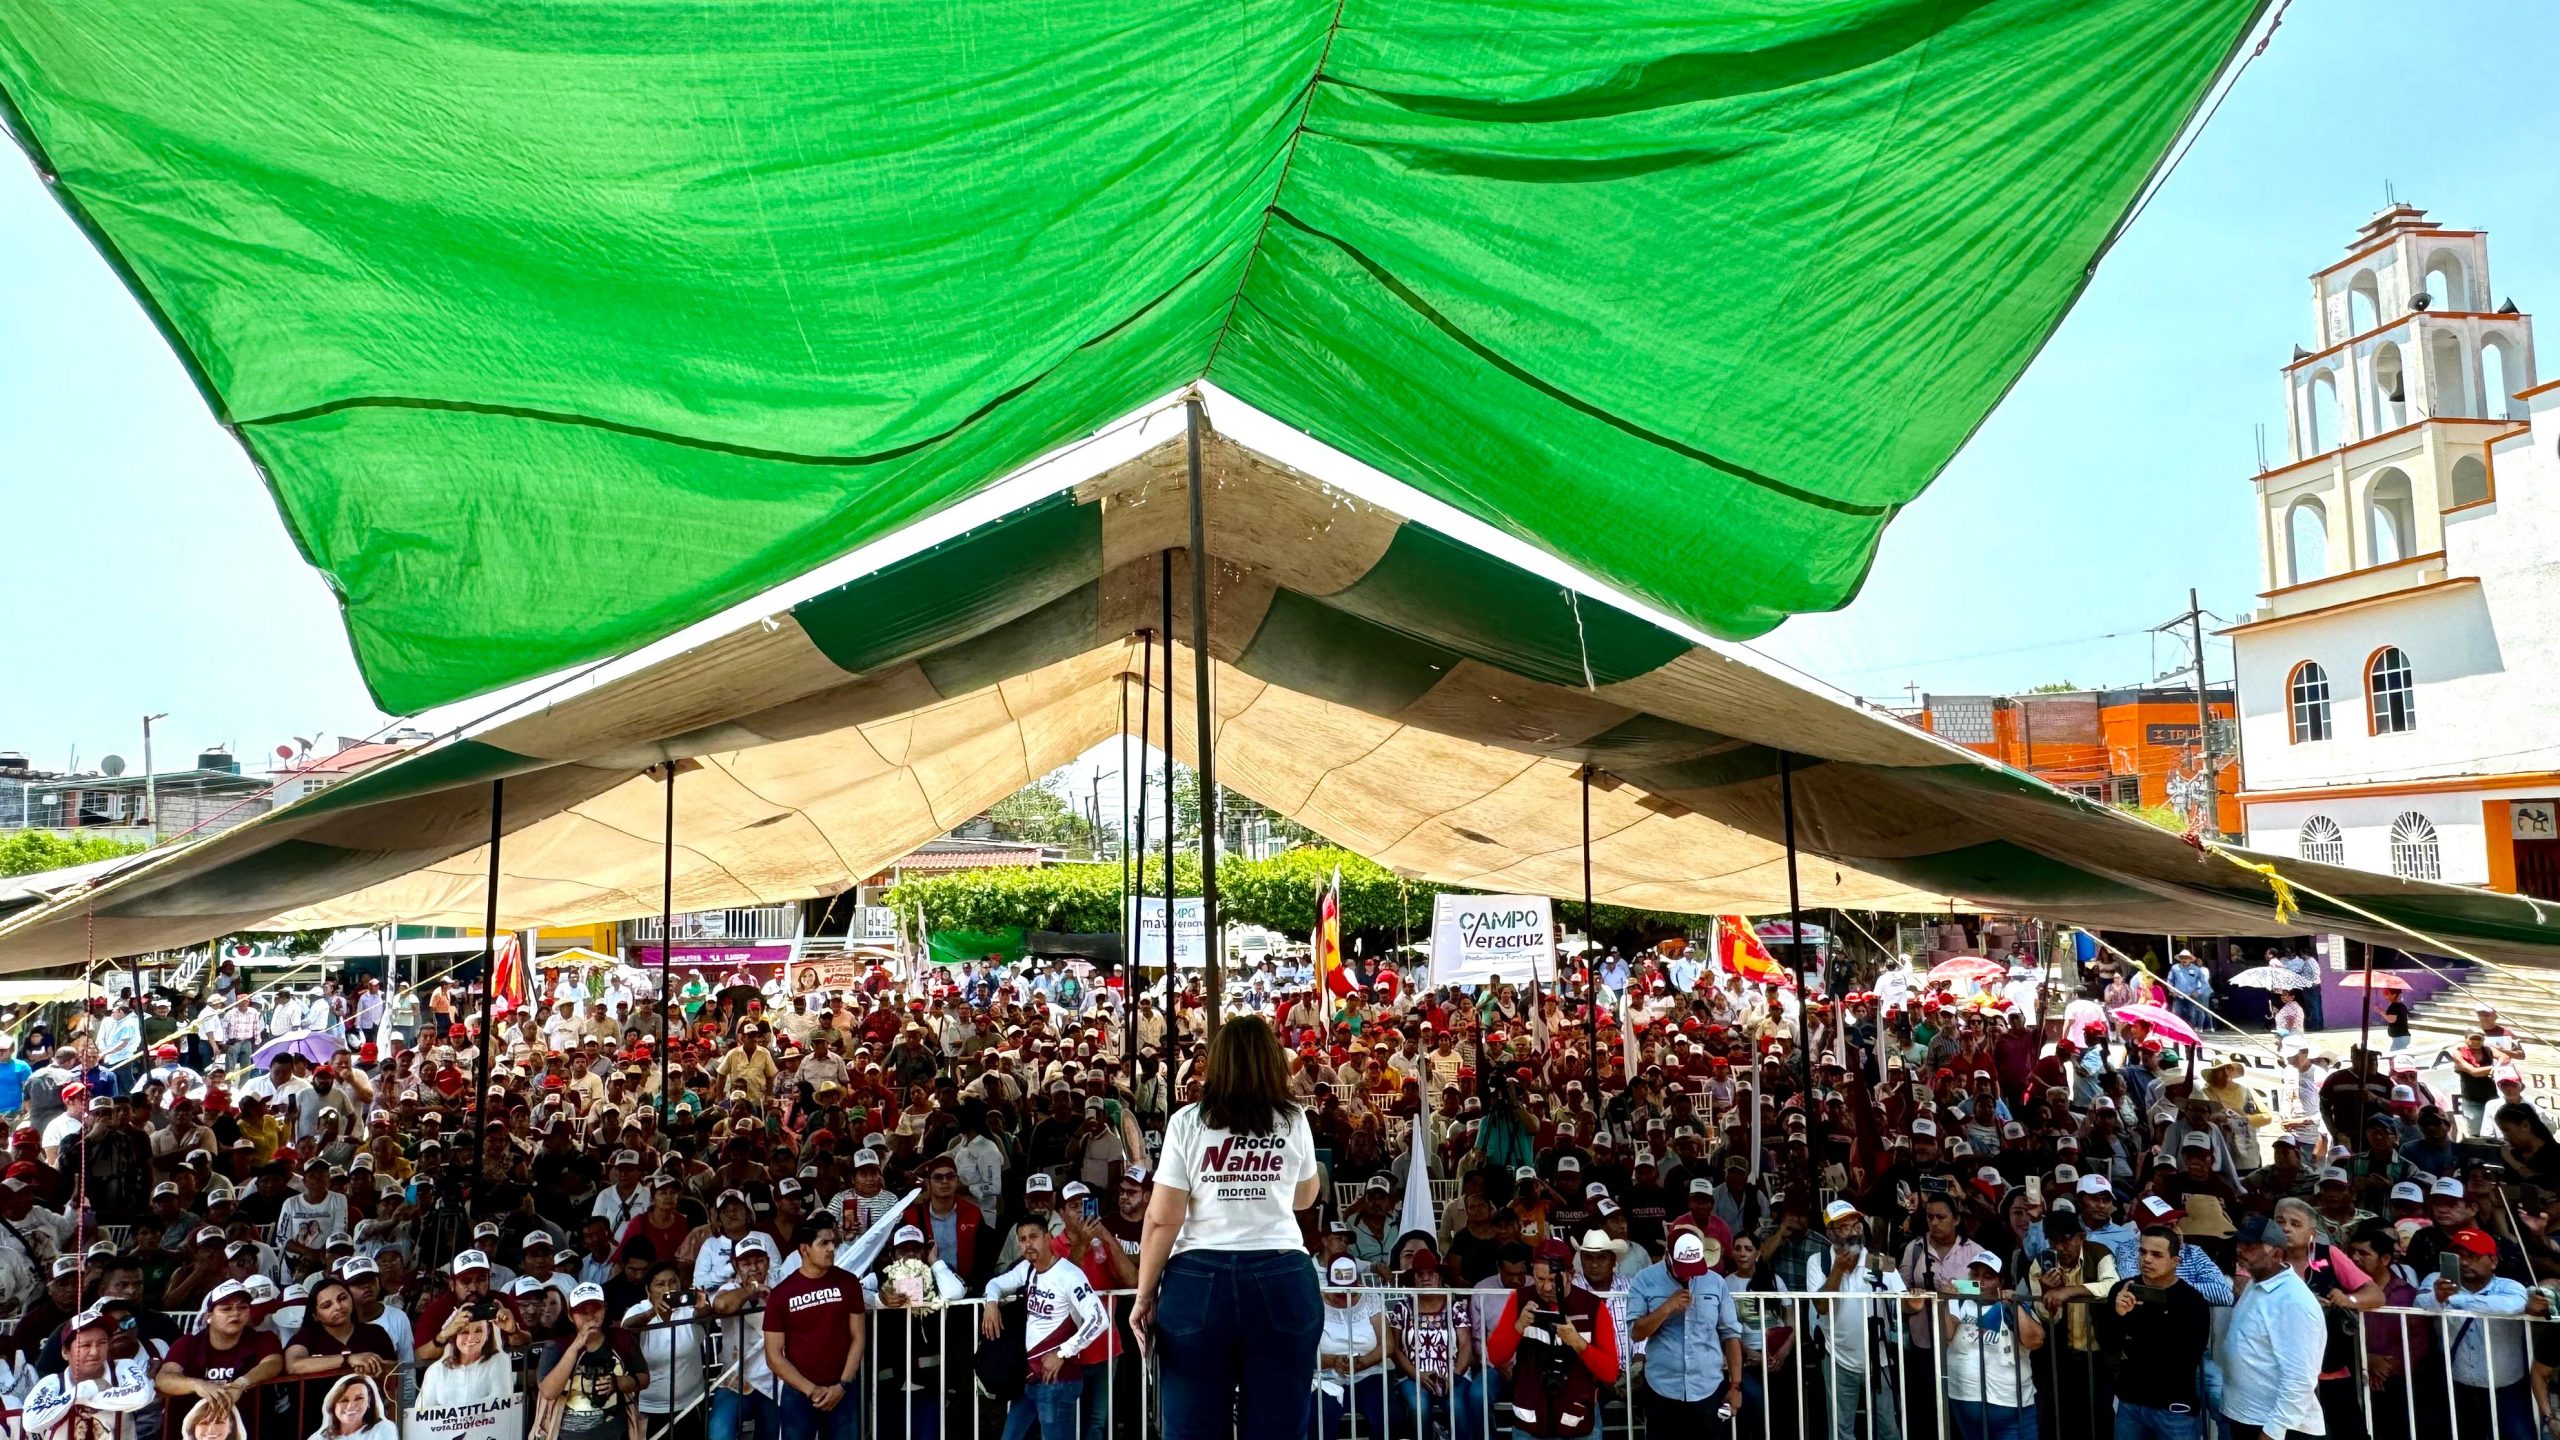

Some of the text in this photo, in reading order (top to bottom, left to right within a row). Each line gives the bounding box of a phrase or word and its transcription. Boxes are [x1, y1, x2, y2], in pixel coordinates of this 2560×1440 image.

[1459, 910, 1538, 930] CAMPO
[1463, 932, 1544, 949] Veracruz
[1234, 1134, 1286, 1150] Rocío
[1200, 1135, 1284, 1173] Nahle
[1201, 1173, 1281, 1183] GOBERNADORA
[1217, 1187, 1267, 1197] morena
[789, 1287, 842, 1308] morena
[415, 1397, 511, 1421] MINATITLÁN
